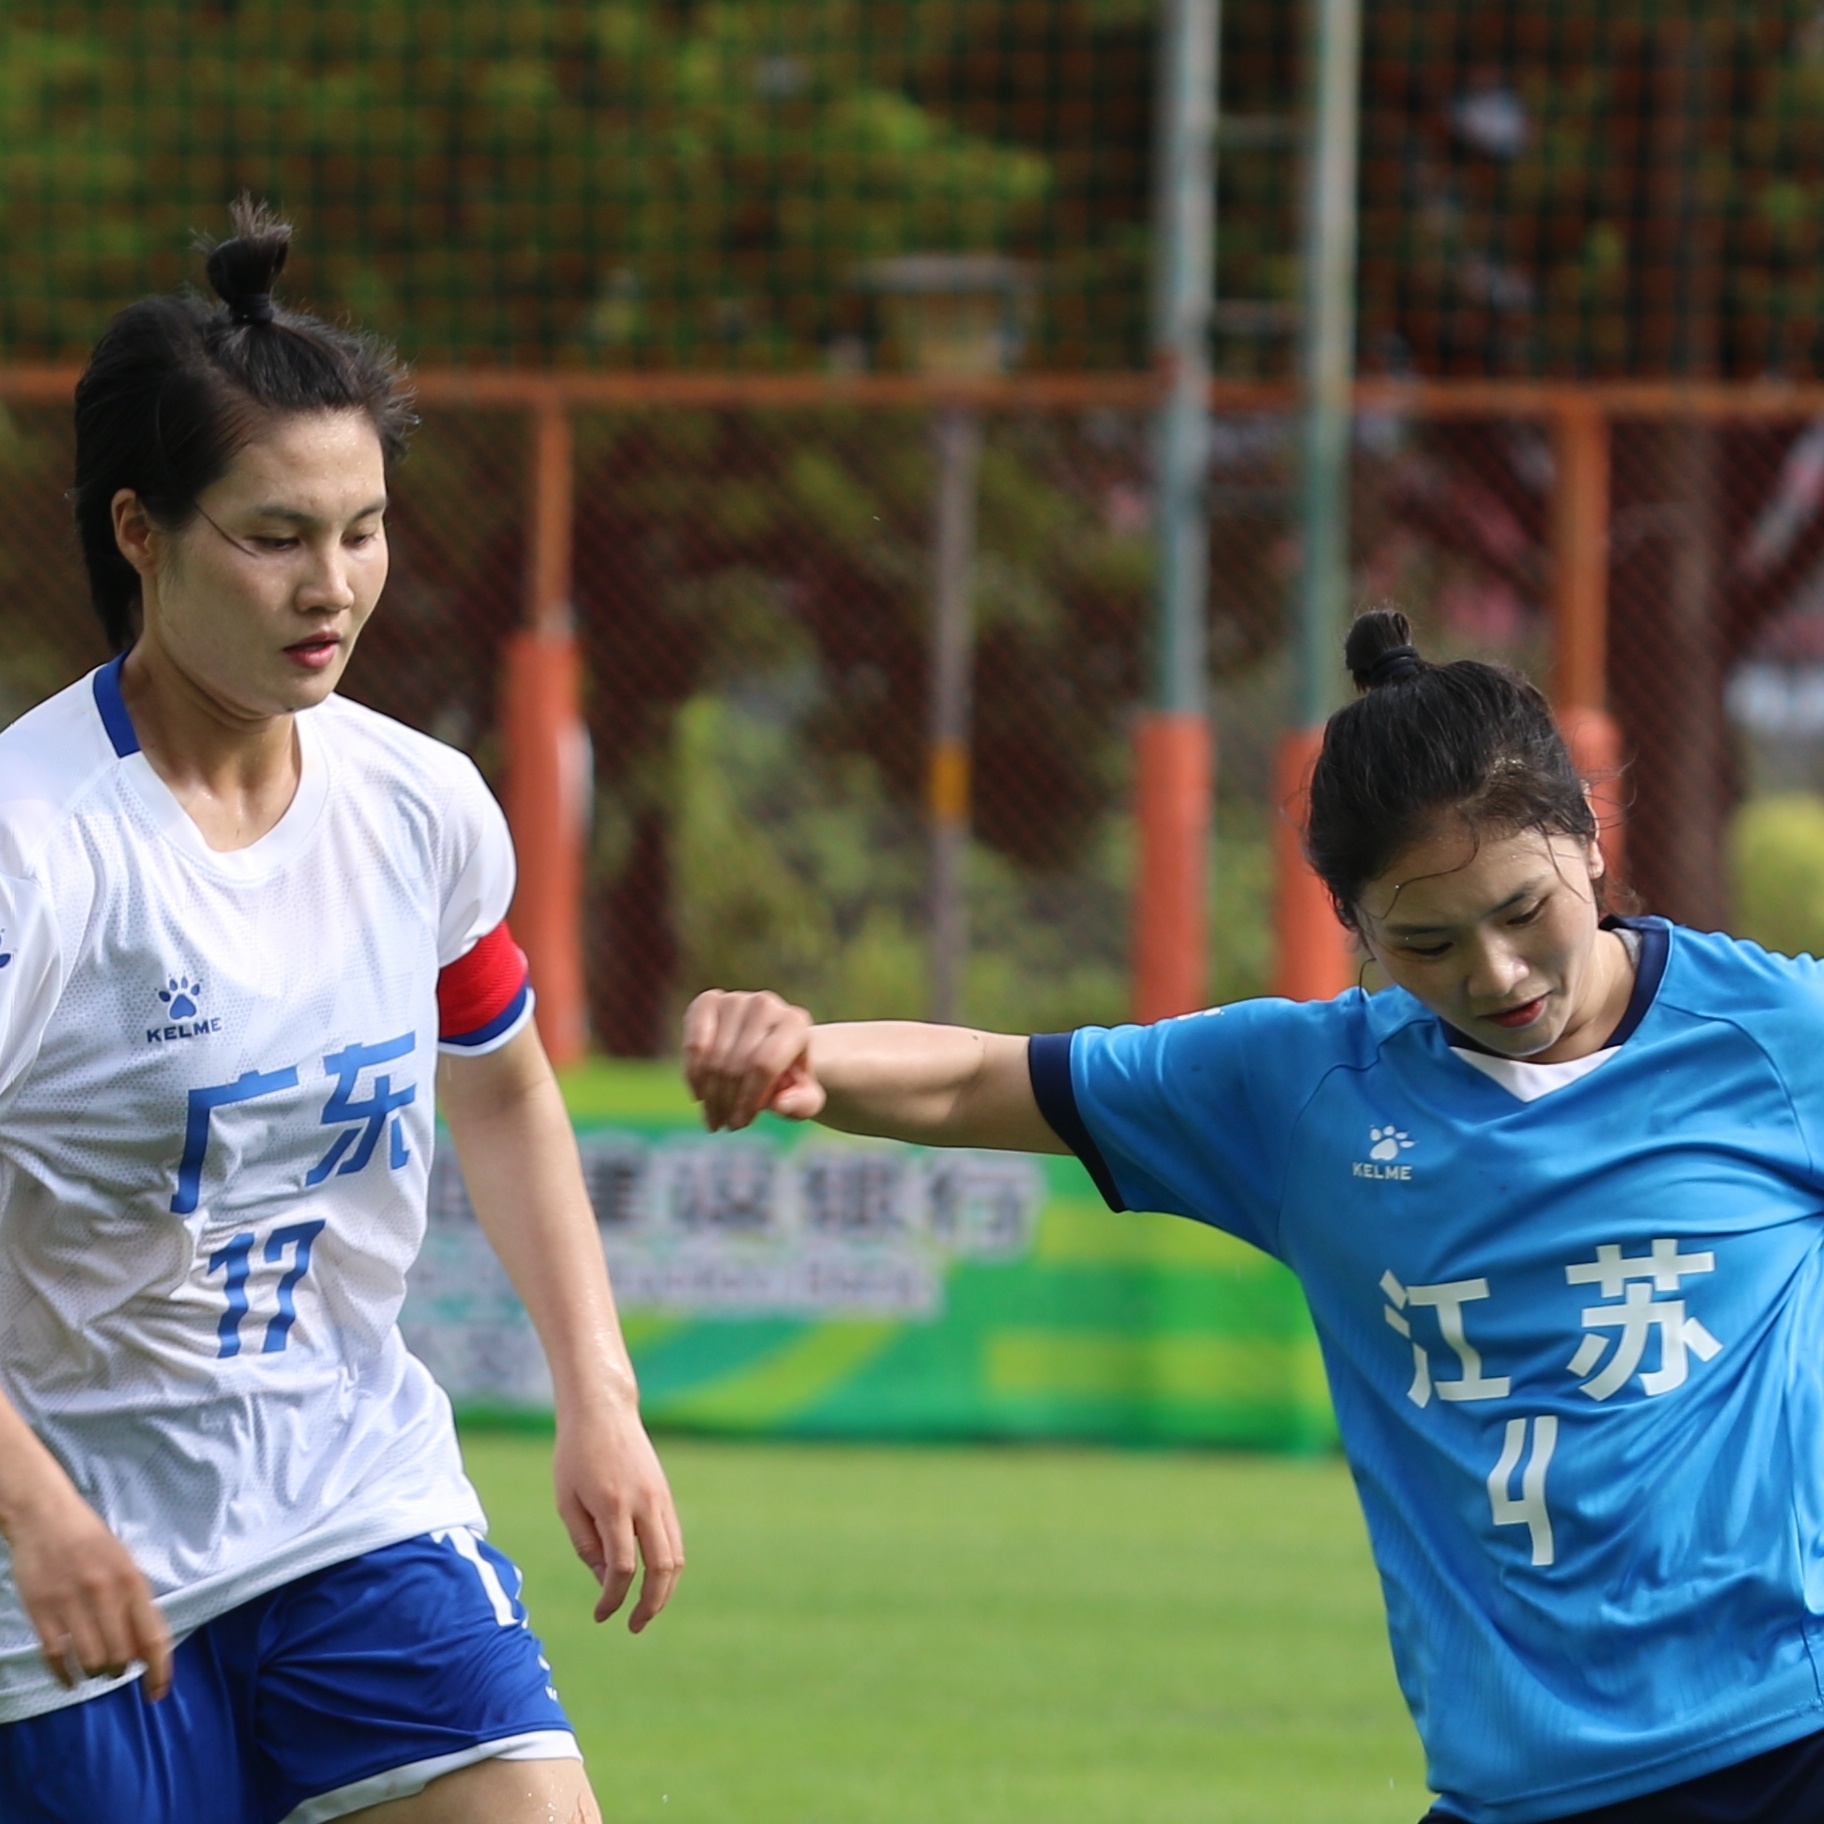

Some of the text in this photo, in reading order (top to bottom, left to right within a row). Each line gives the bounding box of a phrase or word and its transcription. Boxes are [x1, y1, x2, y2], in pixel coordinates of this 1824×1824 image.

[146, 1016, 223, 1043] KELME
[169, 1030, 417, 1214] 广东
[1352, 1161, 1413, 1180] KELME
[208, 1219, 326, 1359] 17
[1379, 1238, 1724, 1408] 江苏
[1487, 1415, 1558, 1566] 4
